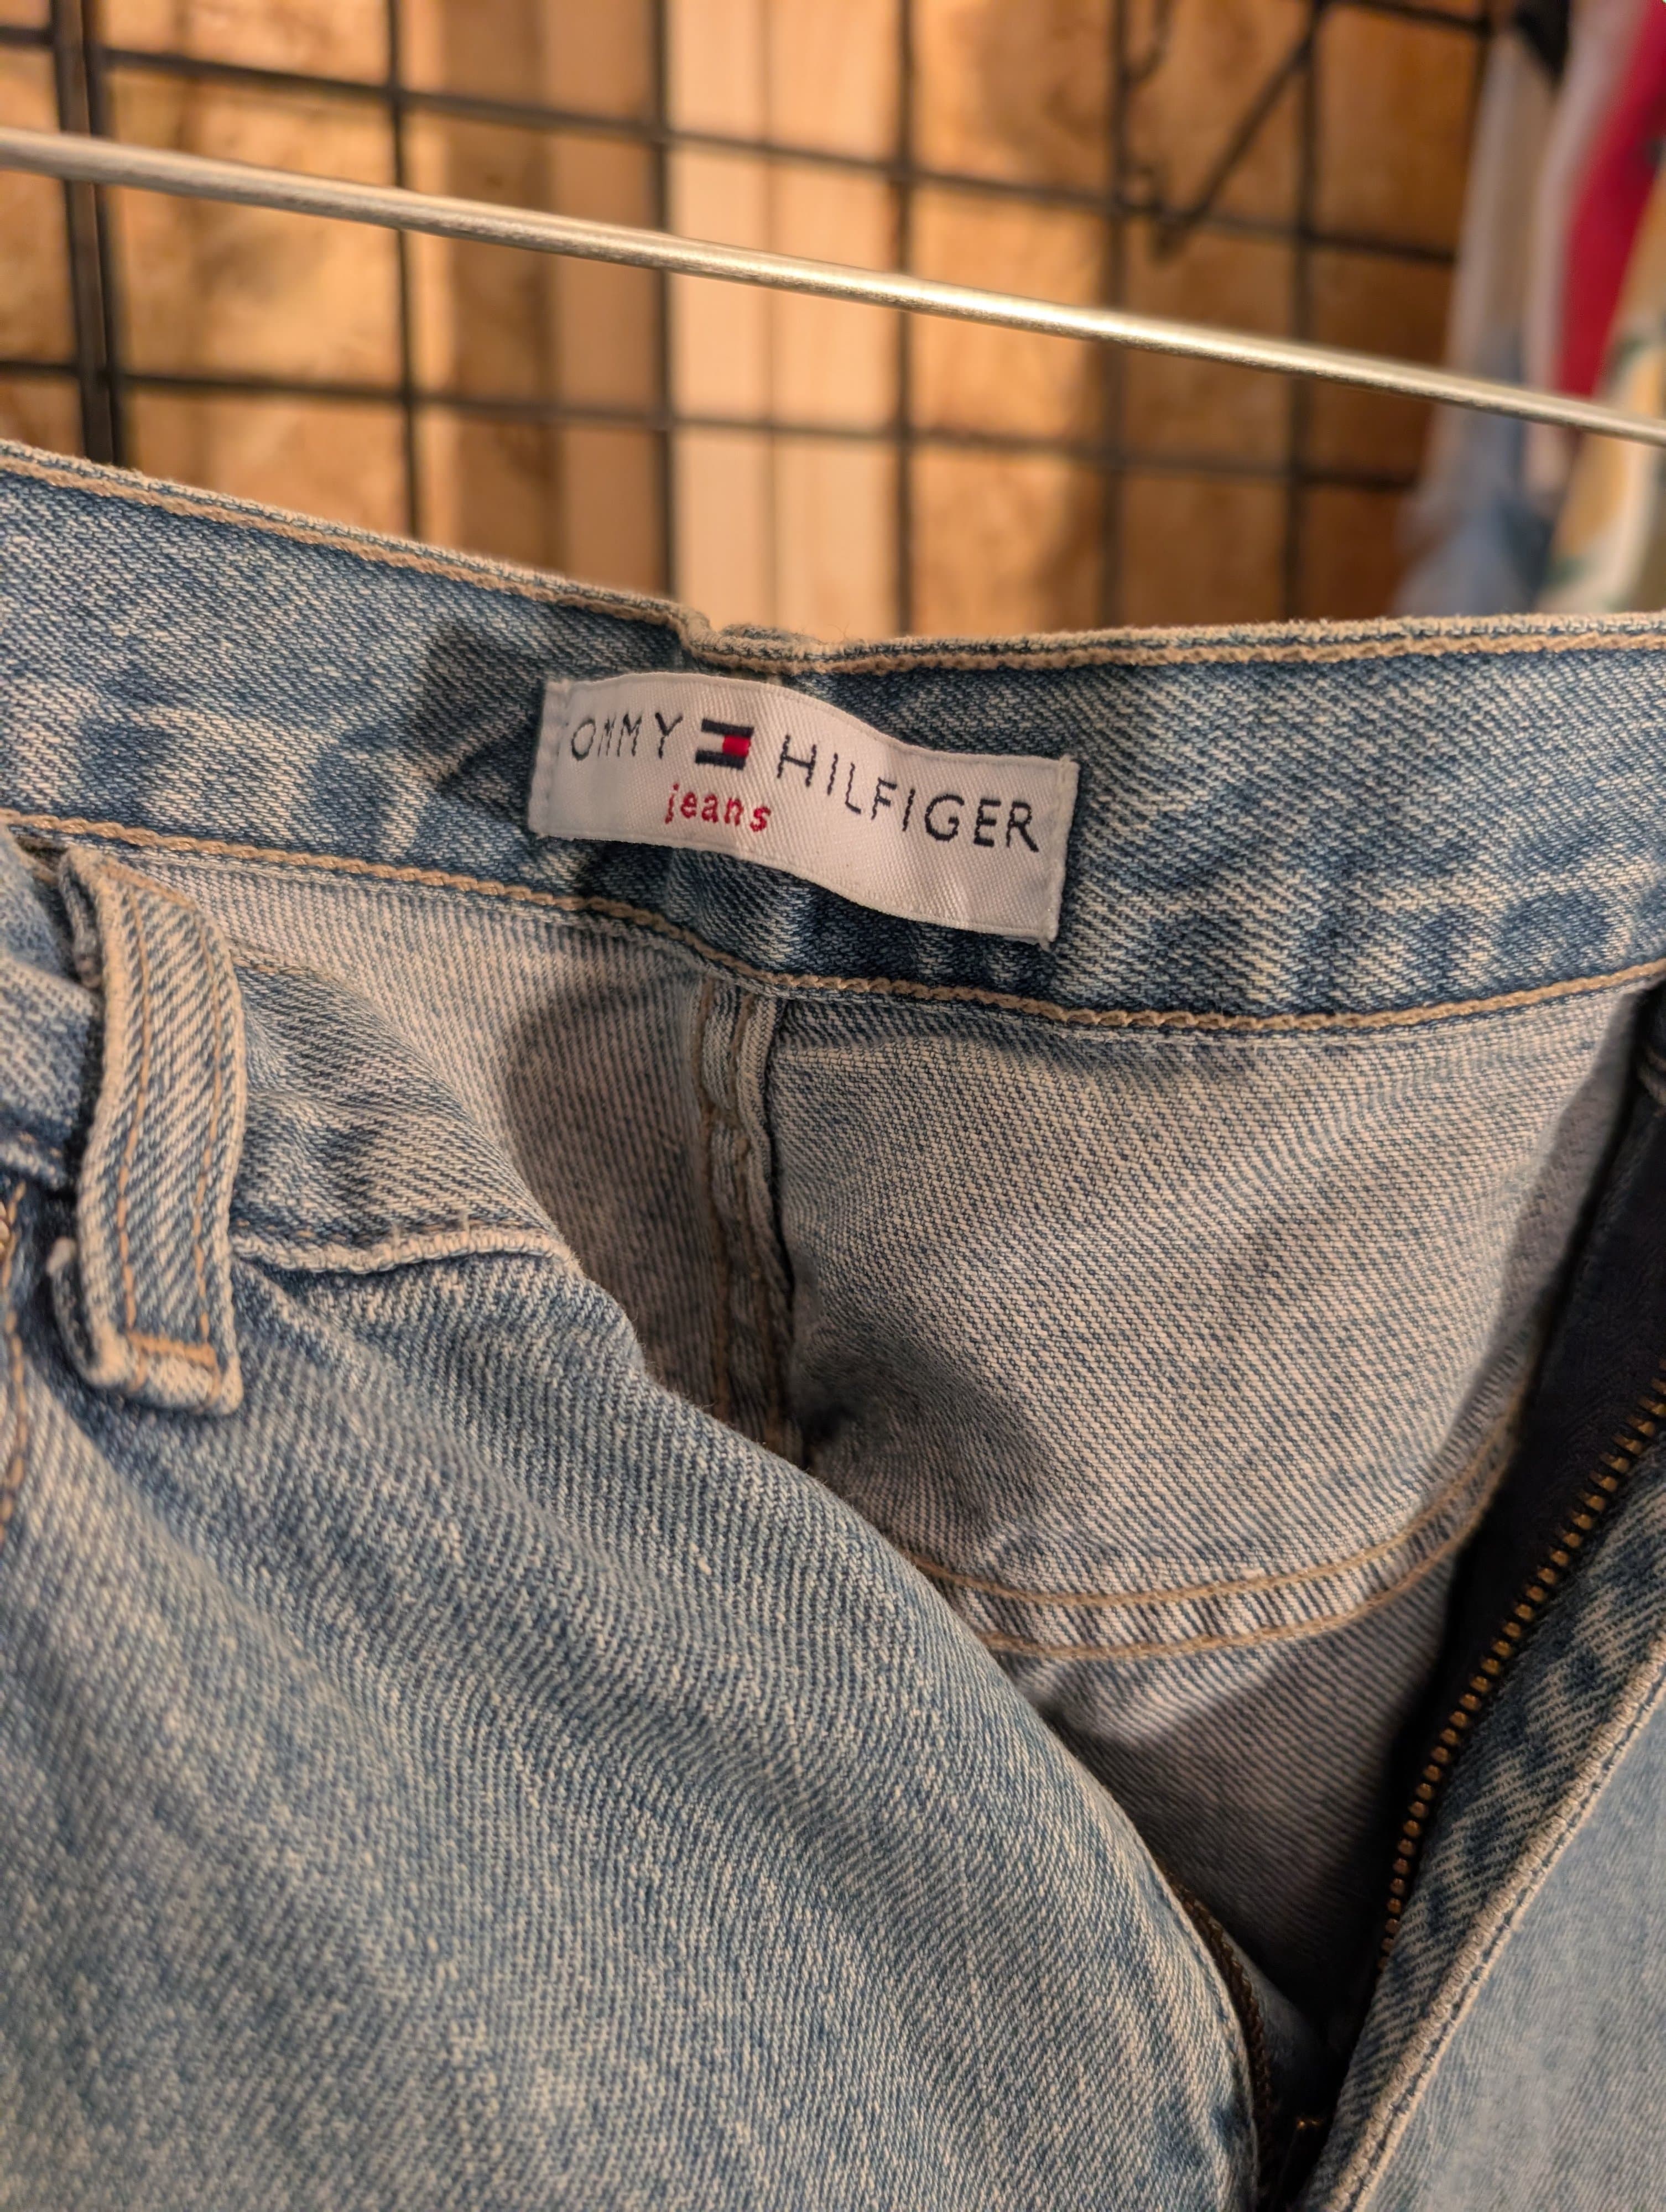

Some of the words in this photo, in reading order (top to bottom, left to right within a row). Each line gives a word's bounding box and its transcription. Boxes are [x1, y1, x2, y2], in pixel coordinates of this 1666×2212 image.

[556, 712, 684, 761] OMMY
[775, 734, 1040, 852] HILFIGER
[664, 783, 772, 832] jeans
